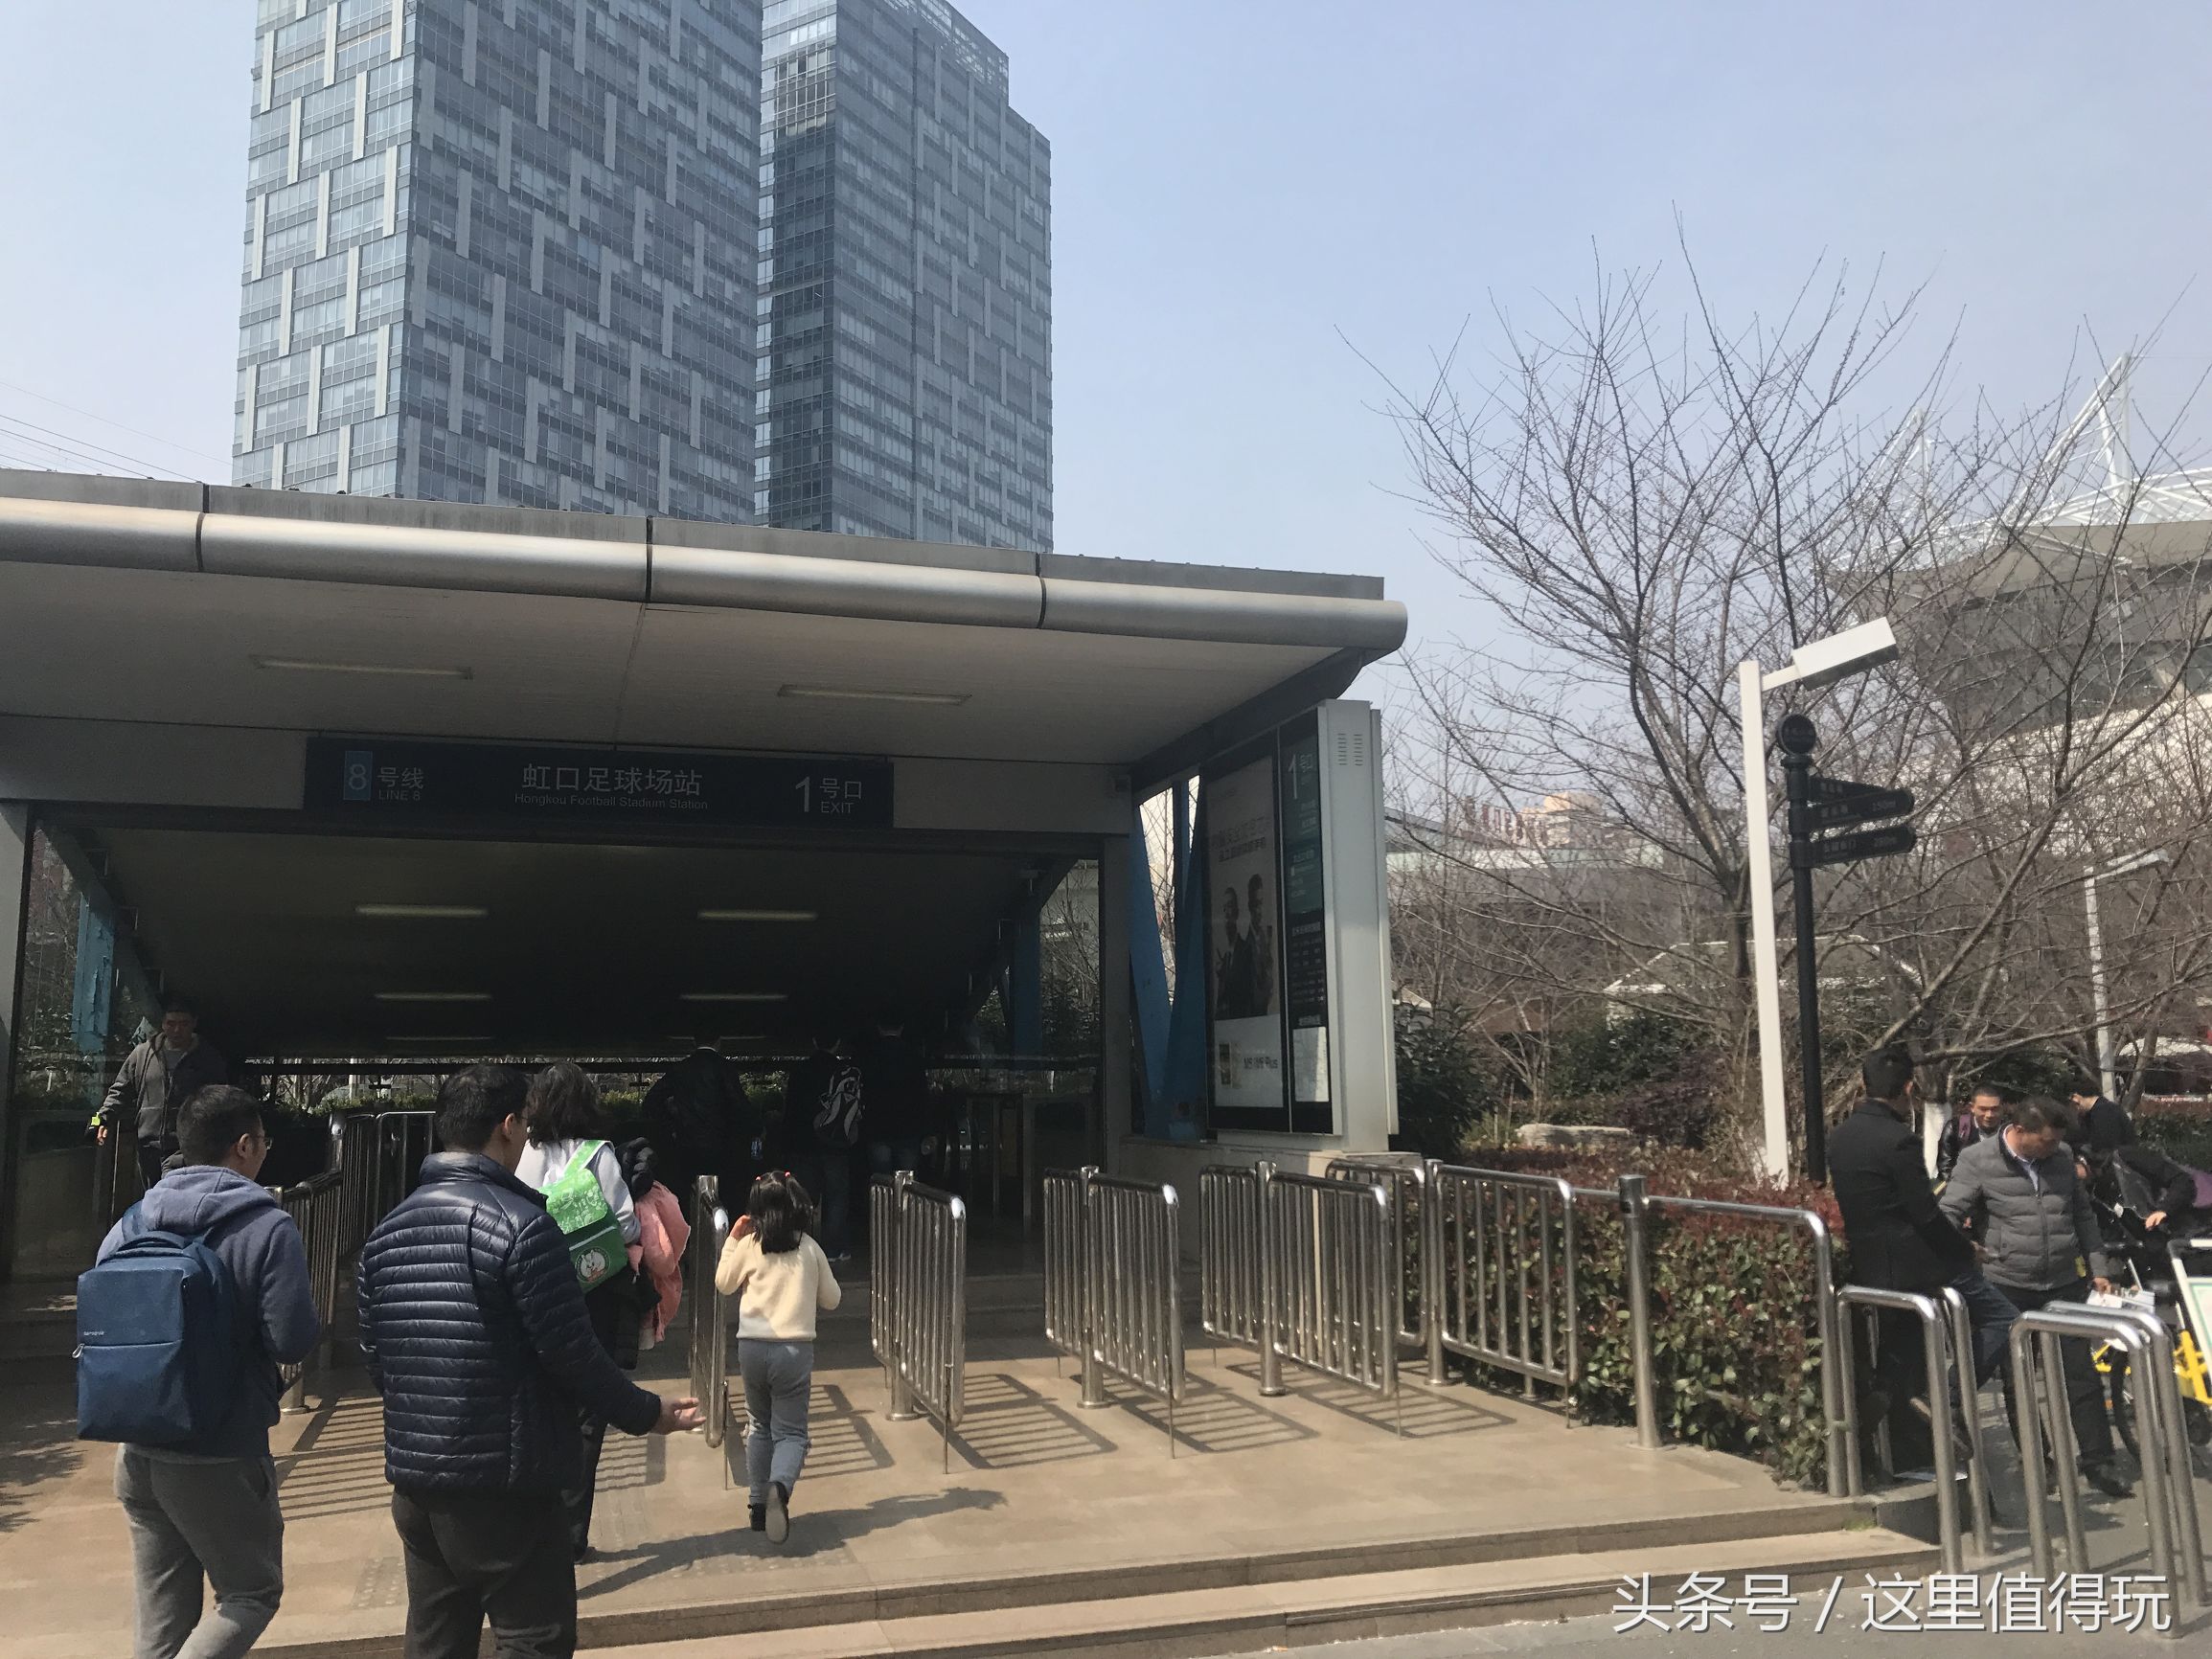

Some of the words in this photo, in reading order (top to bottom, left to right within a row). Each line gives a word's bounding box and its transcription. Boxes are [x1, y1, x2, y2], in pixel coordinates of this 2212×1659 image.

[348, 764, 367, 790] 8
[377, 767, 424, 790] 号线
[522, 763, 703, 796] 虹口足球场站
[378, 789, 409, 801] LINE
[413, 790, 422, 802] 8
[514, 793, 567, 807] Hongkou
[570, 795, 617, 807] Football
[619, 797, 666, 808] Stadium
[669, 799, 709, 809] Station
[795, 776, 810, 812] 1
[819, 778, 862, 800] 号口
[820, 801, 855, 813] EXIT
